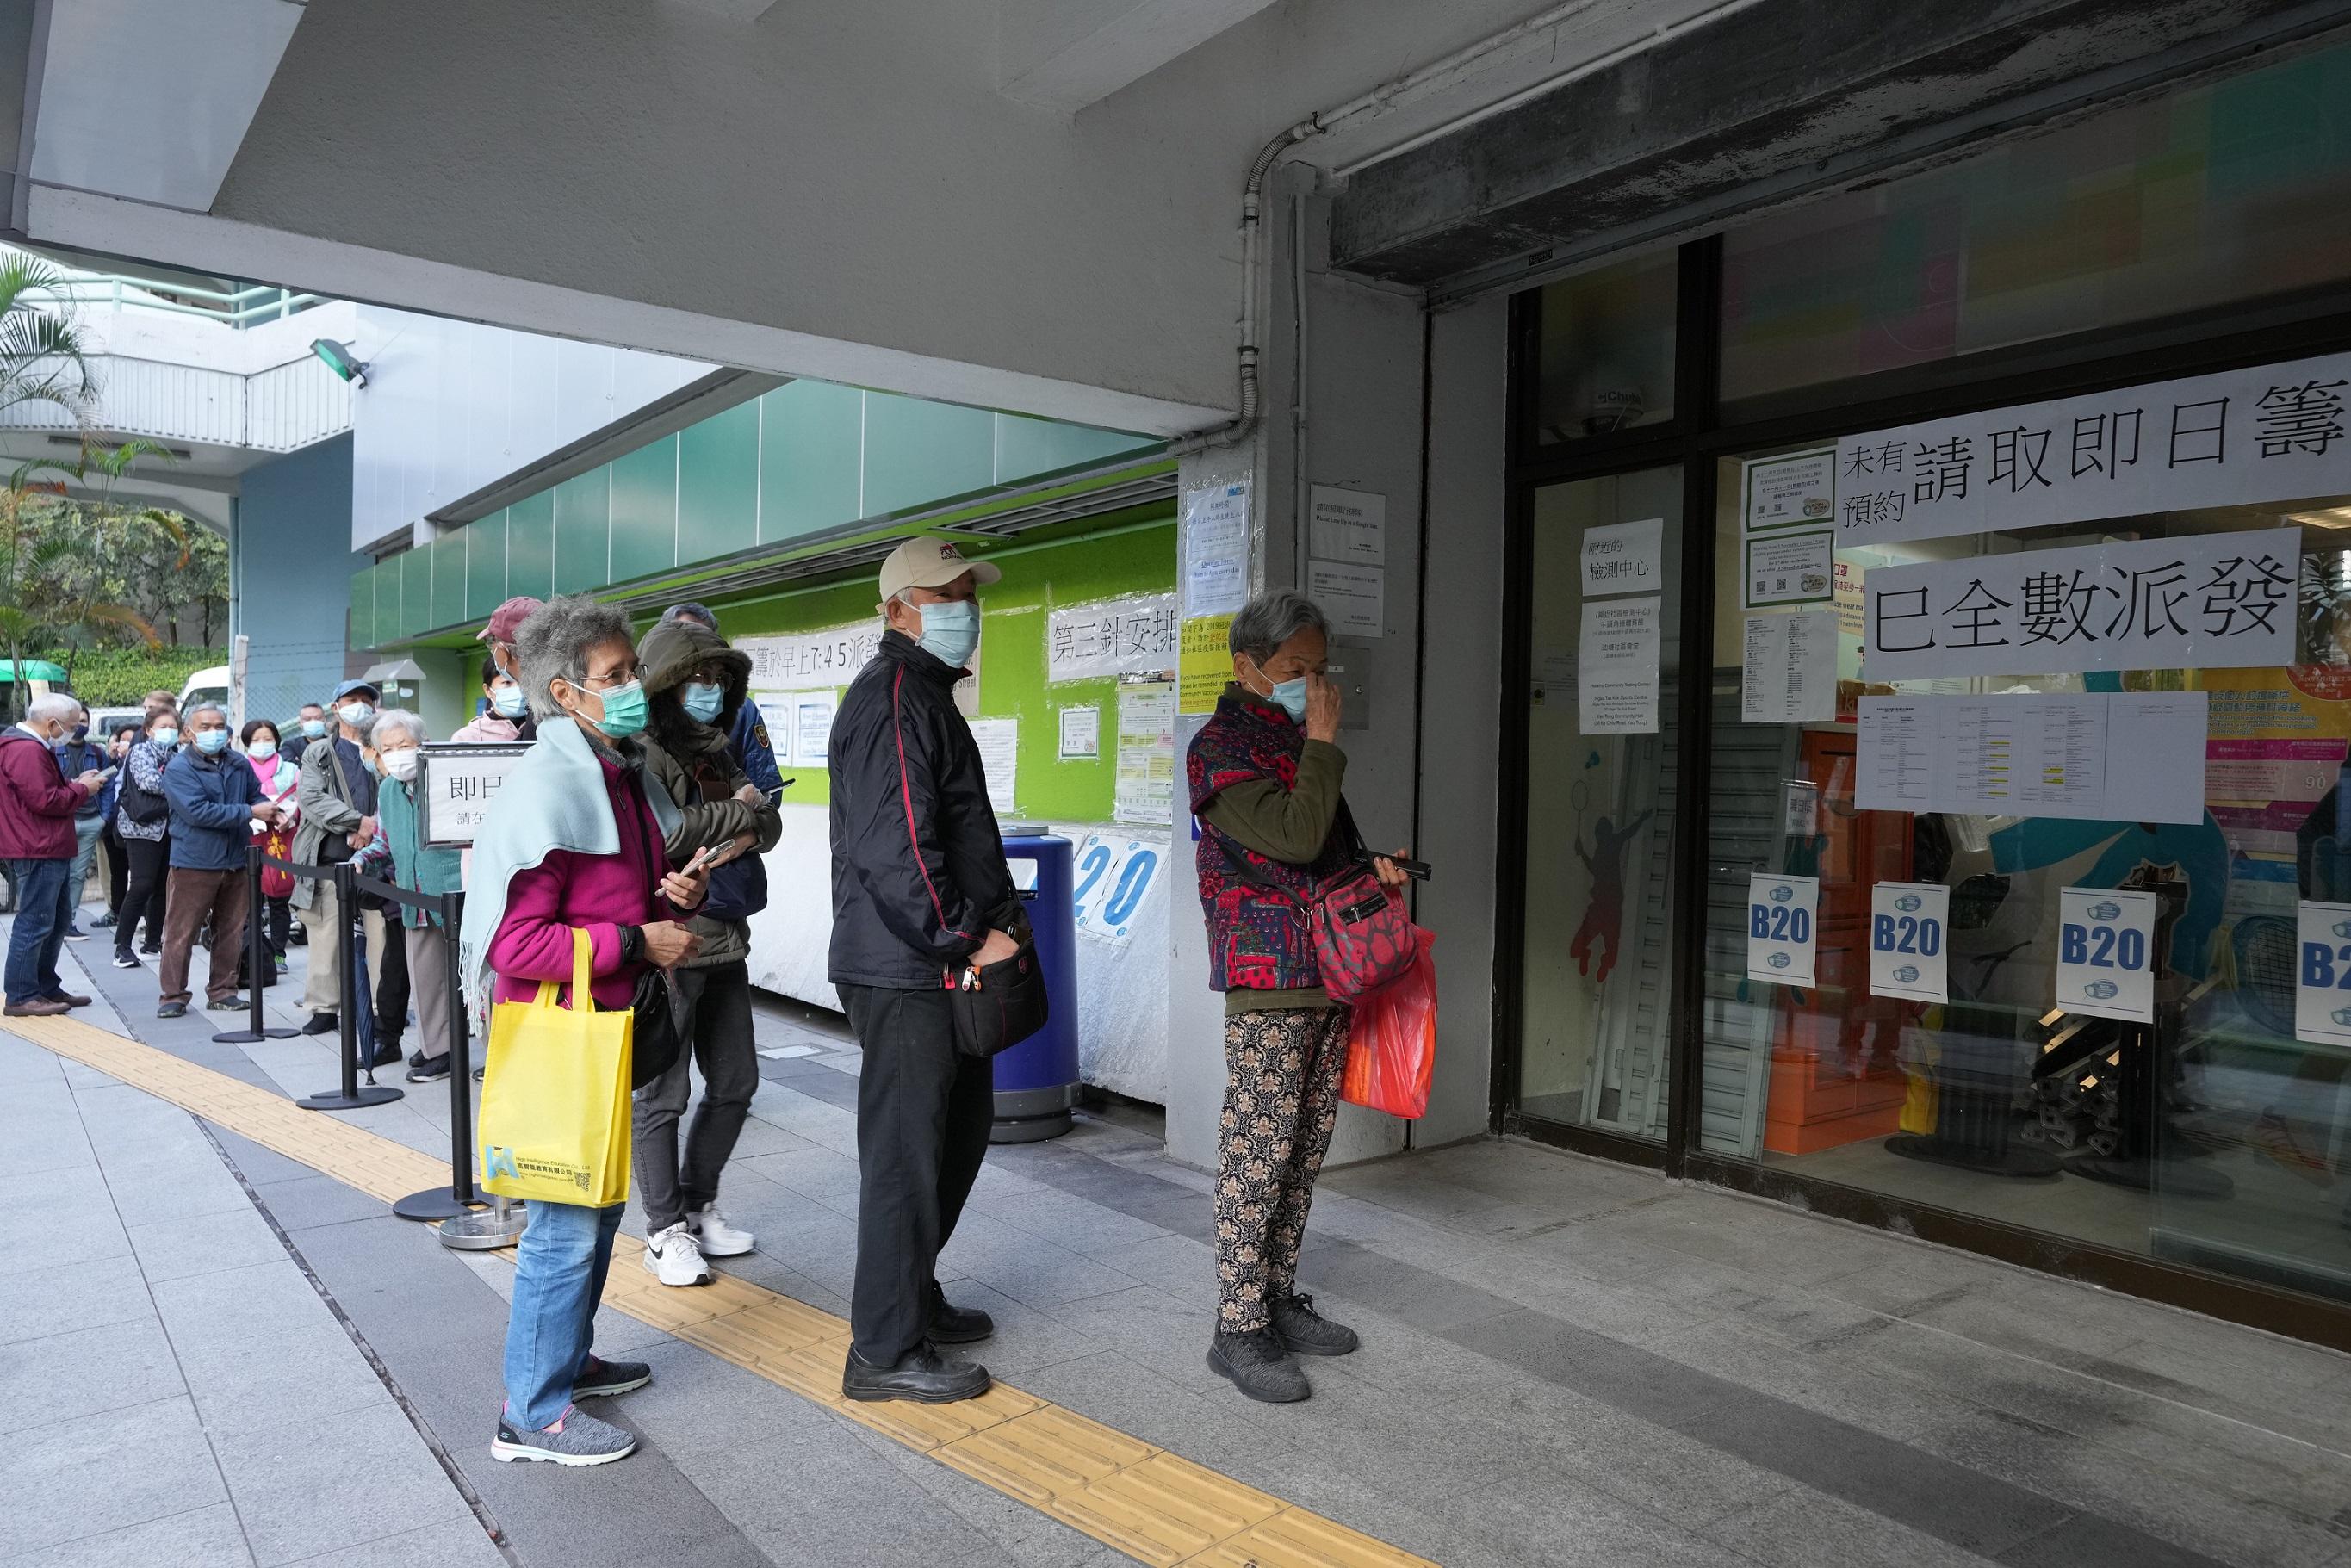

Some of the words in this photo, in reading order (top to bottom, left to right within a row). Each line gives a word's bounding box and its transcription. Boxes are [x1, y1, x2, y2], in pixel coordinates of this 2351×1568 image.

[1843, 440, 1907, 479] 未有
[1913, 379, 2349, 505] 請取即日籌
[1843, 489, 1906, 528] 預約
[1589, 558, 1649, 581] 檢測中心
[1053, 610, 1176, 663] 第三針安排
[1751, 904, 1810, 944] B20
[1874, 914, 1940, 957] B20
[2062, 923, 2144, 971] B20
